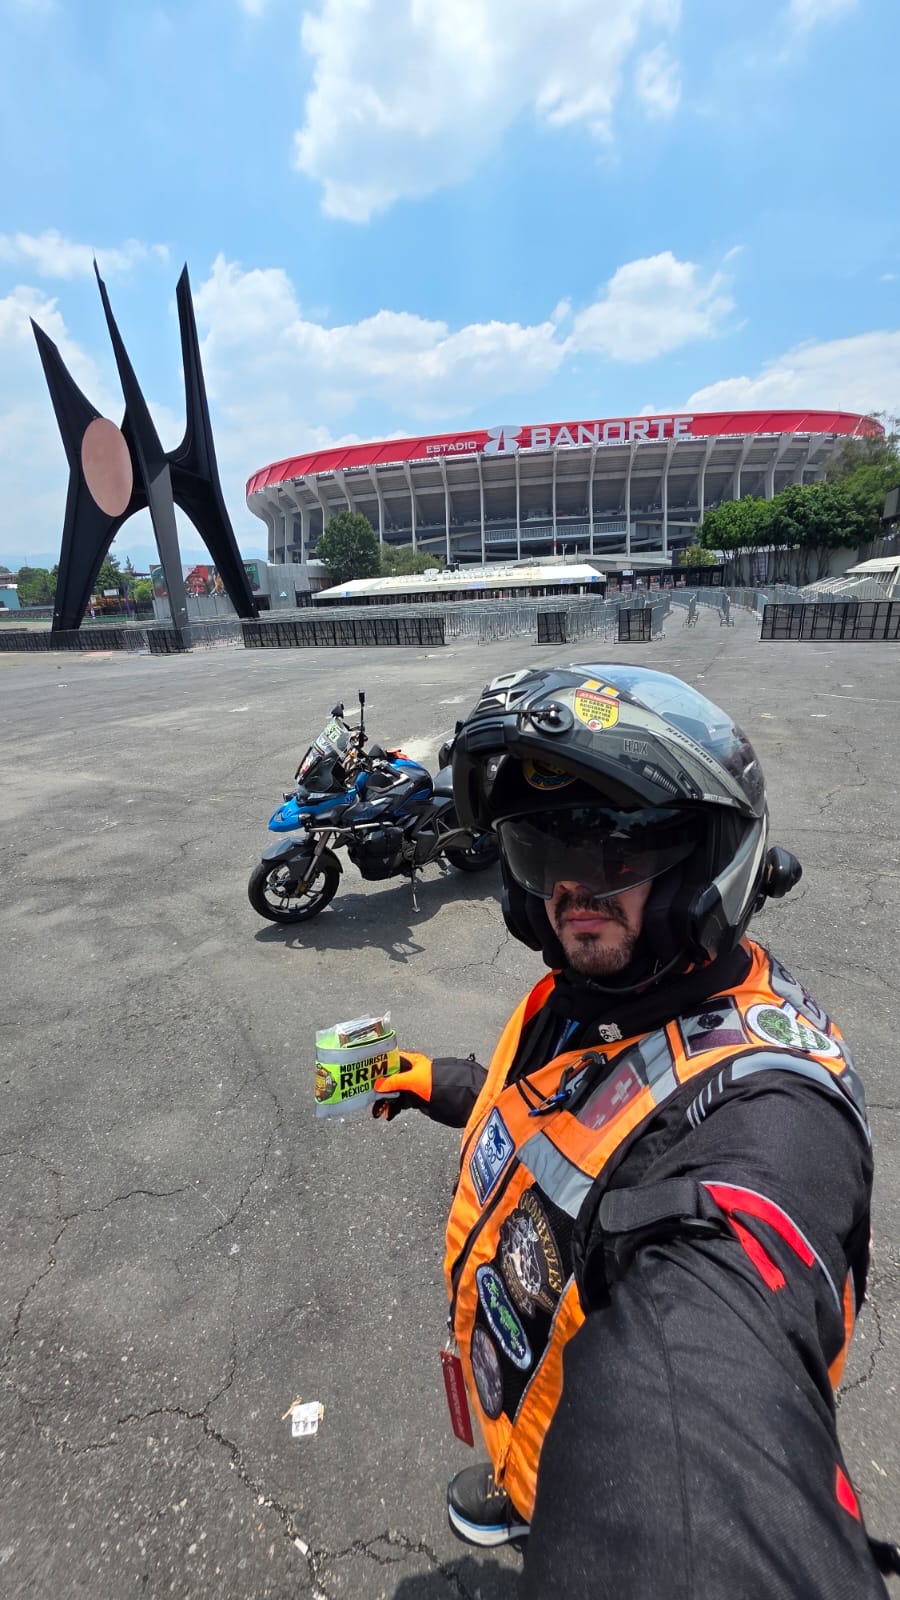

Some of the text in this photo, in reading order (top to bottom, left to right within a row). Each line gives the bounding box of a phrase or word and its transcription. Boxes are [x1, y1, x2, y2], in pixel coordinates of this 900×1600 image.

[426, 417, 694, 454] ESTADIO BANORTE
[623, 738, 649, 756] HAX
[340, 1053, 389, 1073] MOTOTURISTA
[340, 1061, 389, 1090] RRM
